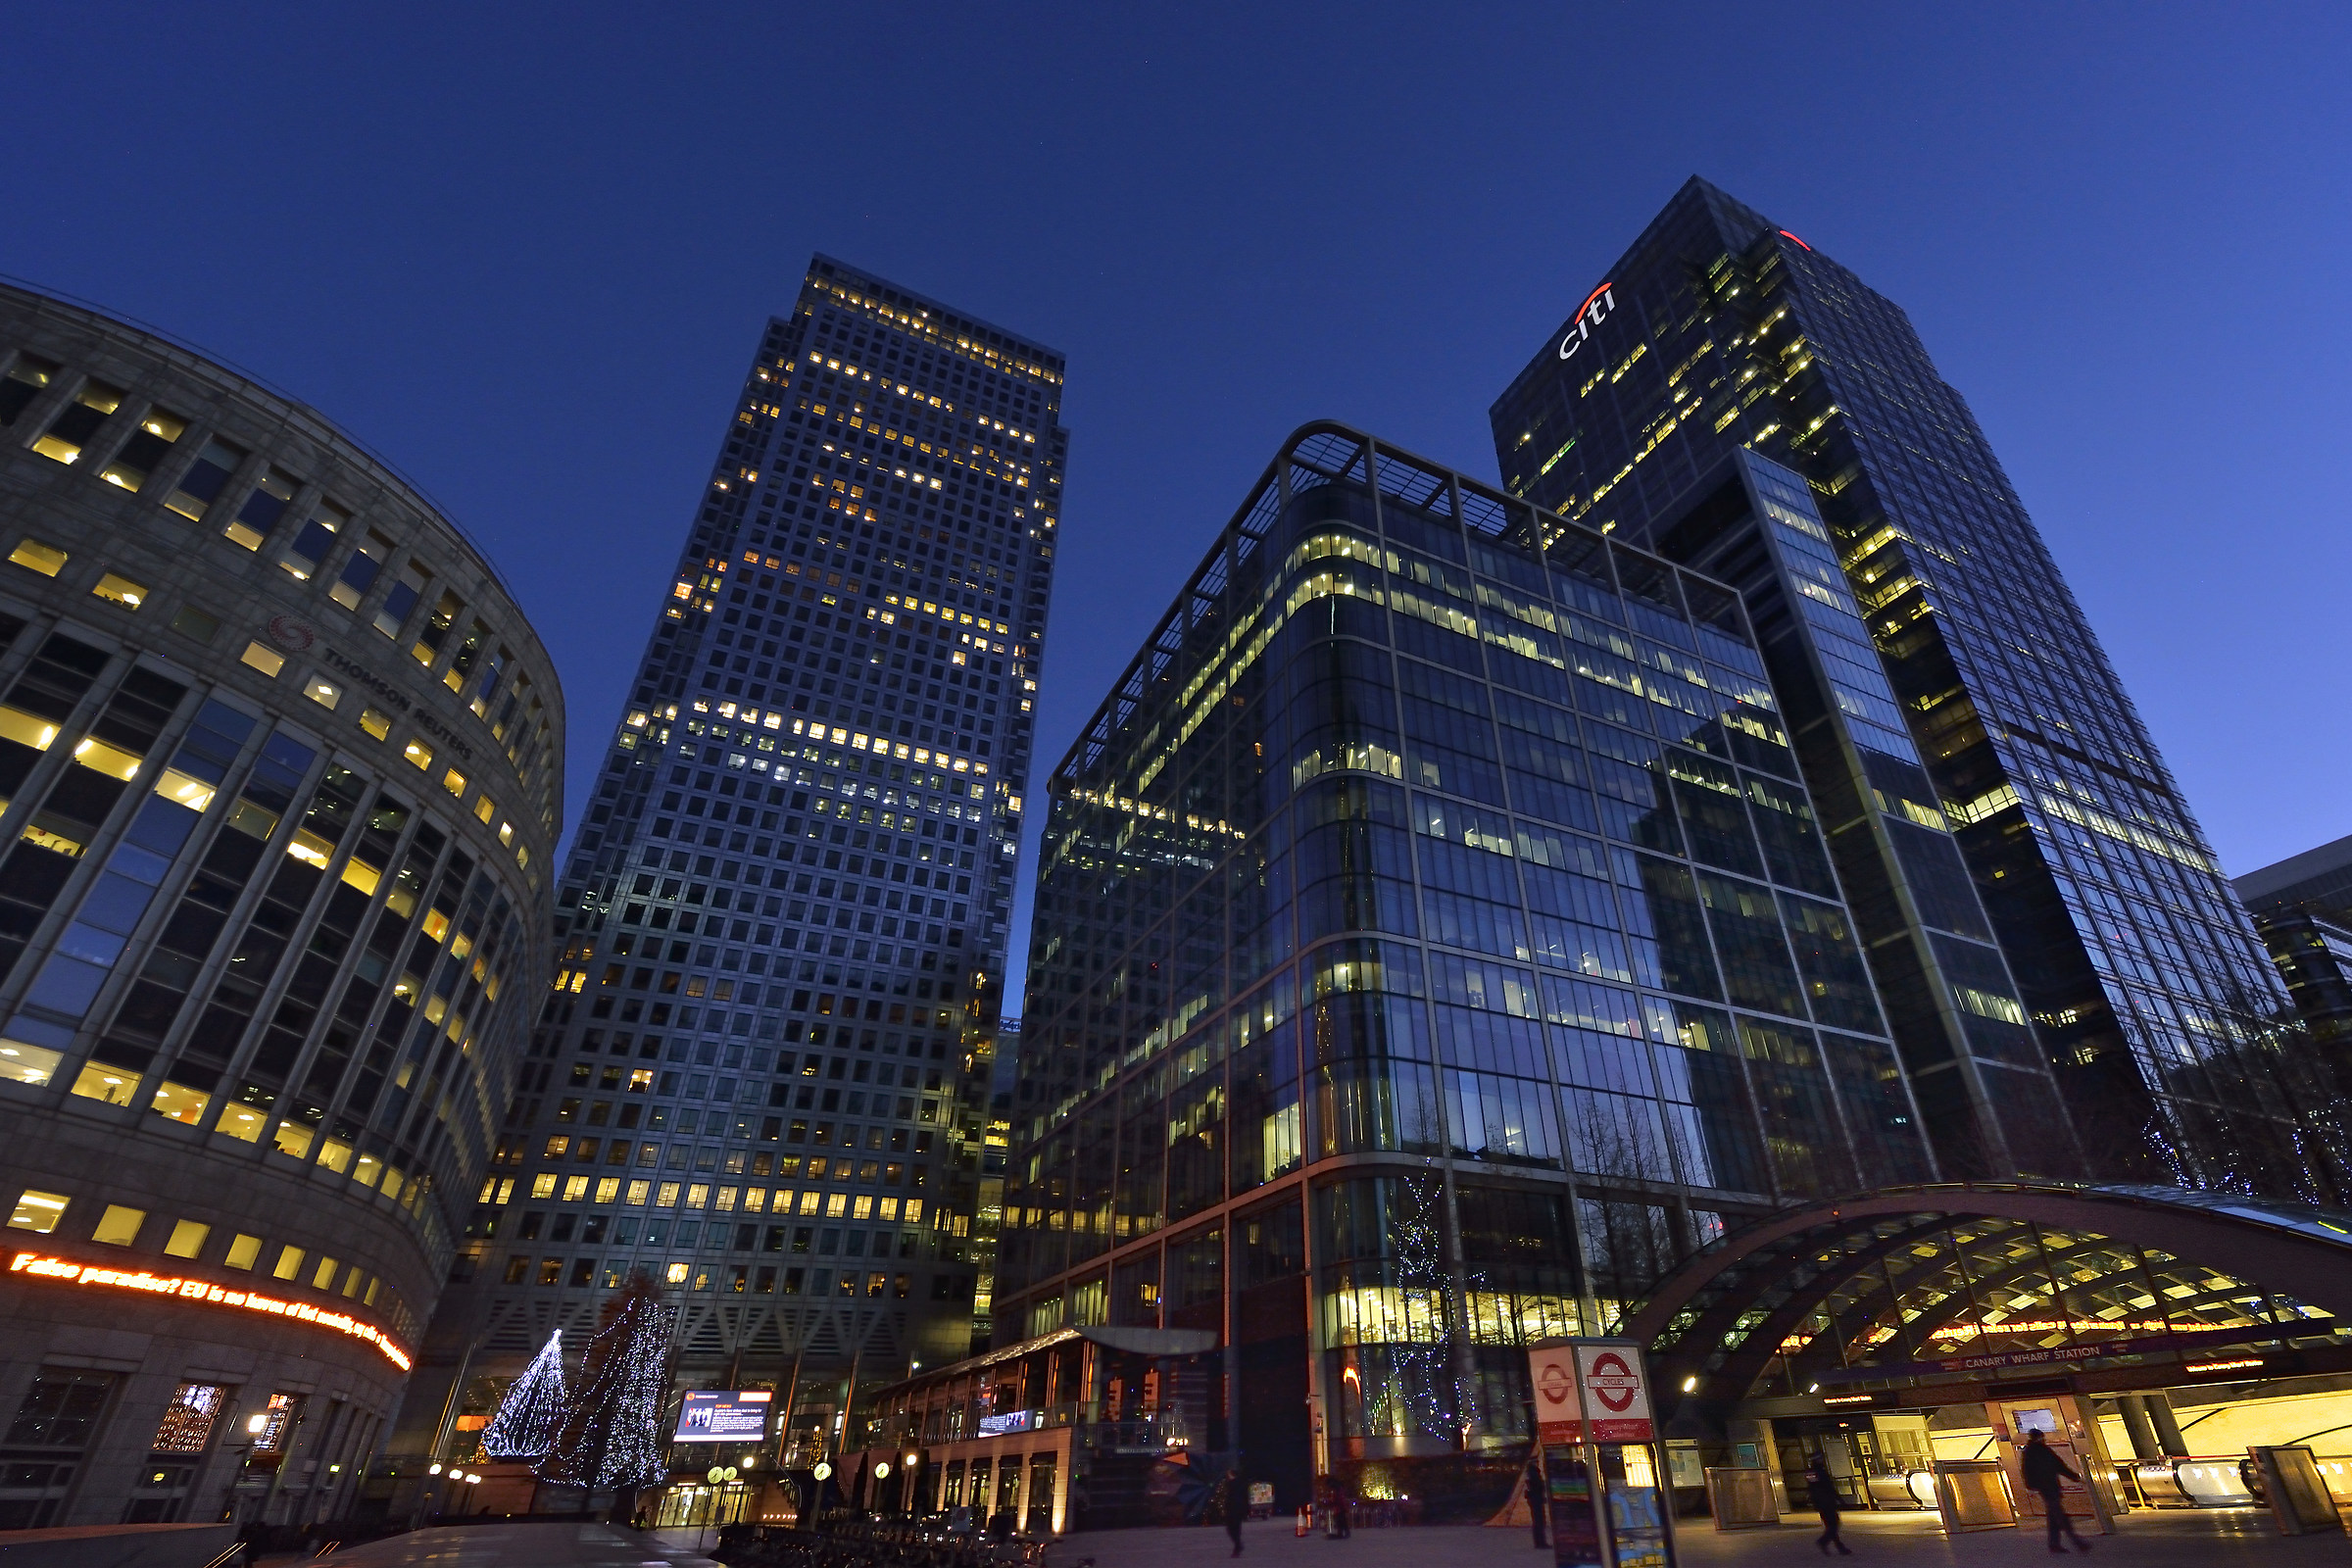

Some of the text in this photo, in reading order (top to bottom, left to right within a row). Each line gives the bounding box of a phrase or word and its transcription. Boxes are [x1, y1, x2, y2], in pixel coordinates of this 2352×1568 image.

[1559, 282, 1615, 360] citi
[325, 648, 472, 760] THOMSON REUTERS
[11, 1254, 80, 1278] False
[78, 1267, 181, 1294] paradise?
[178, 1280, 210, 1298] EU
[206, 1285, 225, 1302] is
[1966, 1356, 2006, 1368] CANARY
[2011, 1351, 2050, 1364] WHARF
[2054, 1347, 2100, 1359] STATION
